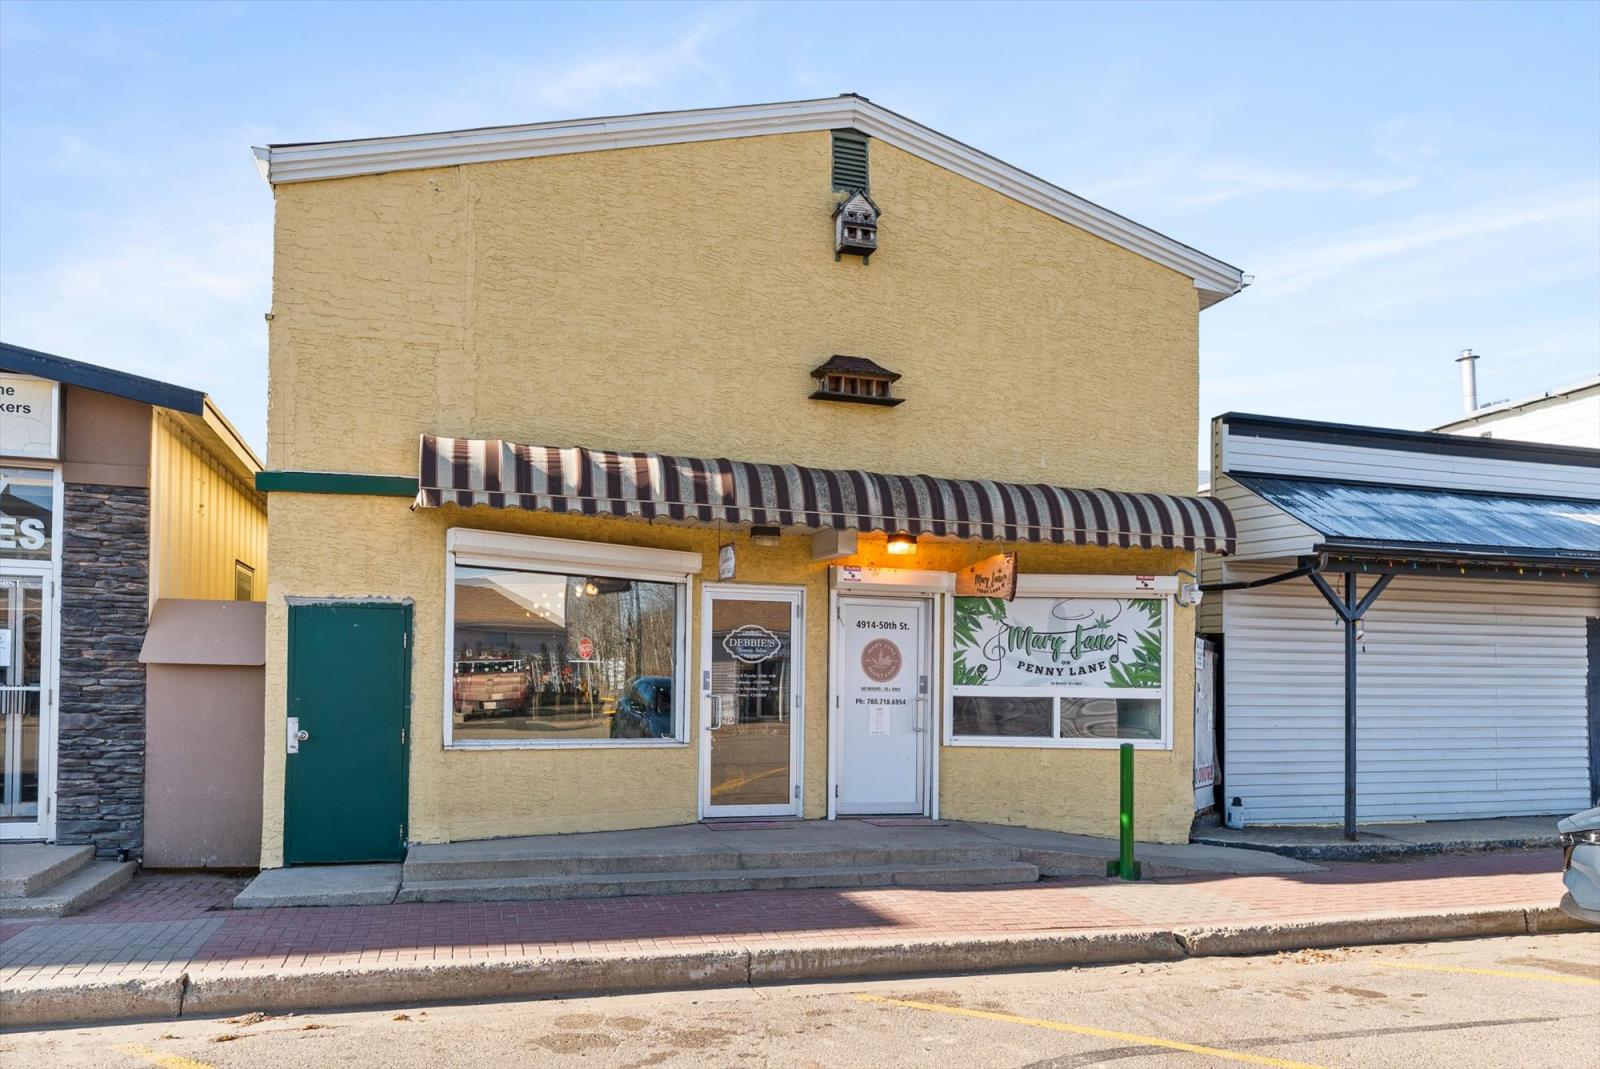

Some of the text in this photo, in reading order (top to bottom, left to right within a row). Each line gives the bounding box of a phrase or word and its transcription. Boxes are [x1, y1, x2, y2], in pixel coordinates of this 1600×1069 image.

[856, 620, 910, 630] 4914-50th St.
[729, 638, 776, 648] DEBBIE'S
[1008, 623, 1117, 663] Mary Jane
[1017, 660, 1107, 676] PENNY LANE
